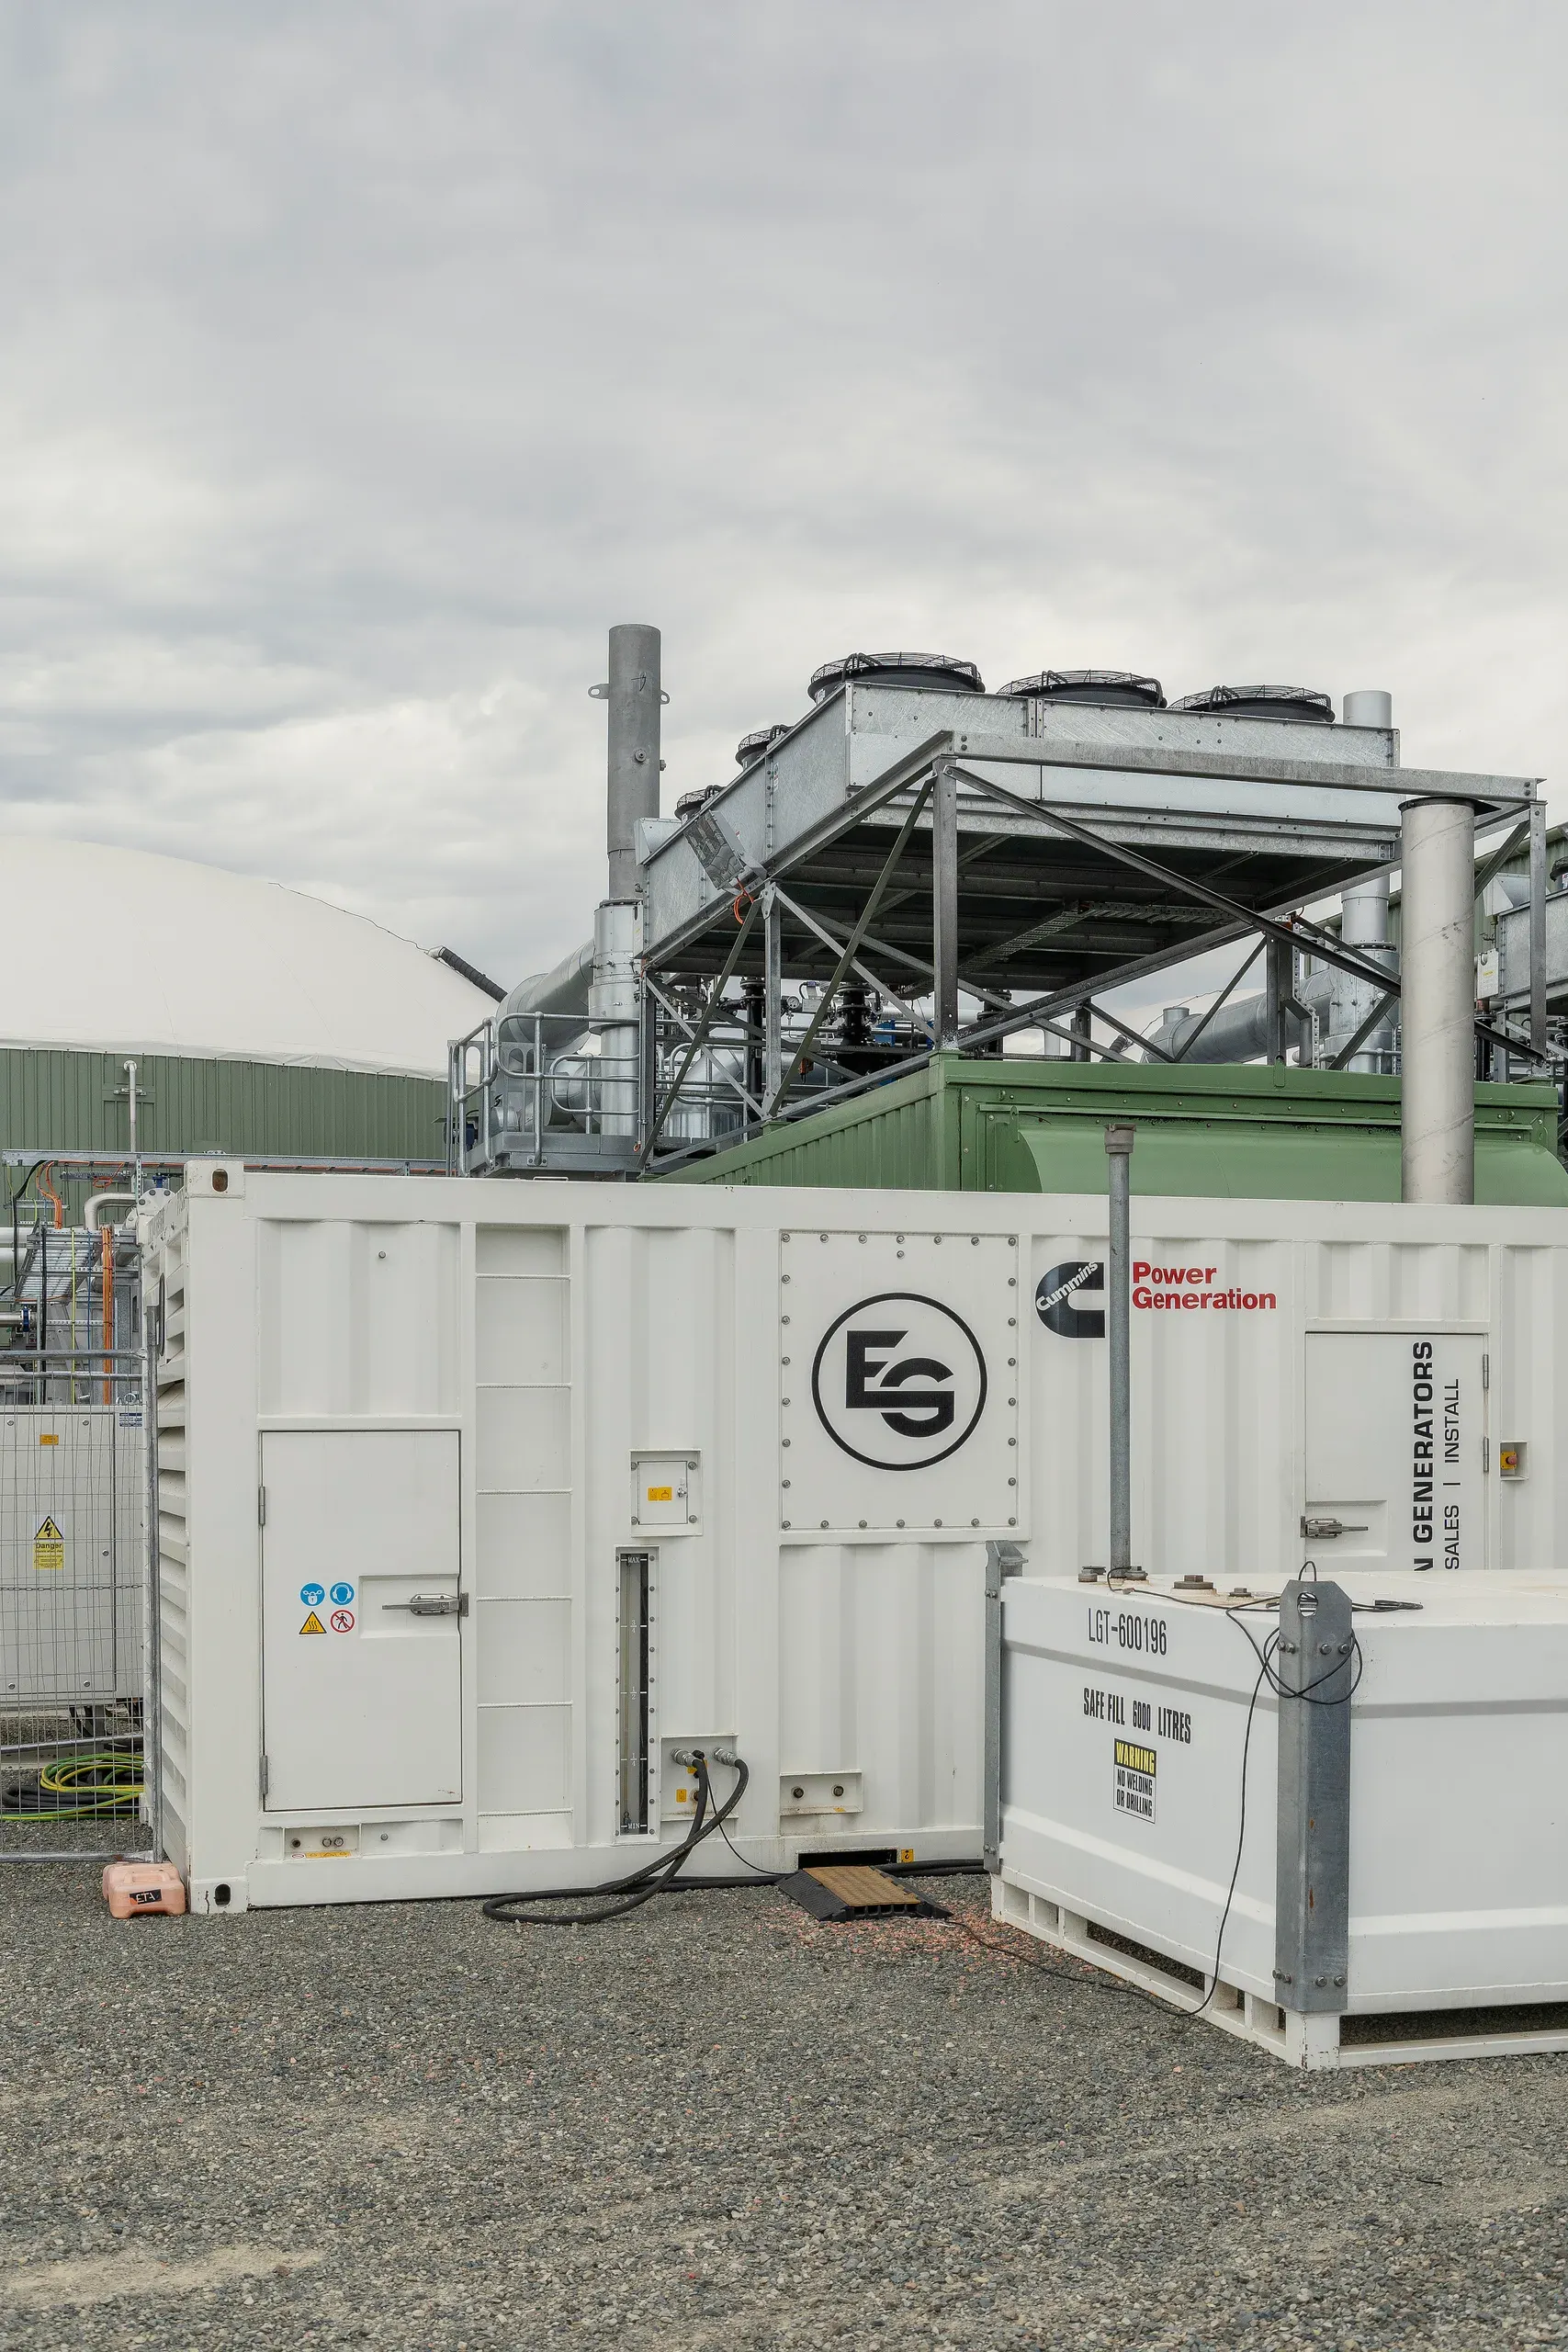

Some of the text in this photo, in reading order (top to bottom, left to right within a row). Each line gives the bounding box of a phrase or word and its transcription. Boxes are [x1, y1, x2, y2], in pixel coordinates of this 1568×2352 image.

[1035, 1261, 1099, 1312] Cummins
[1133, 1261, 1217, 1284] Power
[1132, 1287, 1277, 1310] Generation
[1413, 1341, 1434, 1544] GENERATORS
[1444, 1378, 1460, 1464] INSTALL
[1444, 1505, 1460, 1569] SALES
[1088, 1607, 1167, 1656] LGT-600196
[1083, 1687, 1191, 1744] SAFE FILL 6000 LITRES
[1116, 1741, 1156, 1774] WARNING
[1116, 1788, 1153, 1817] OR DRILLING
[1117, 1768, 1153, 1797] NO WELDING
